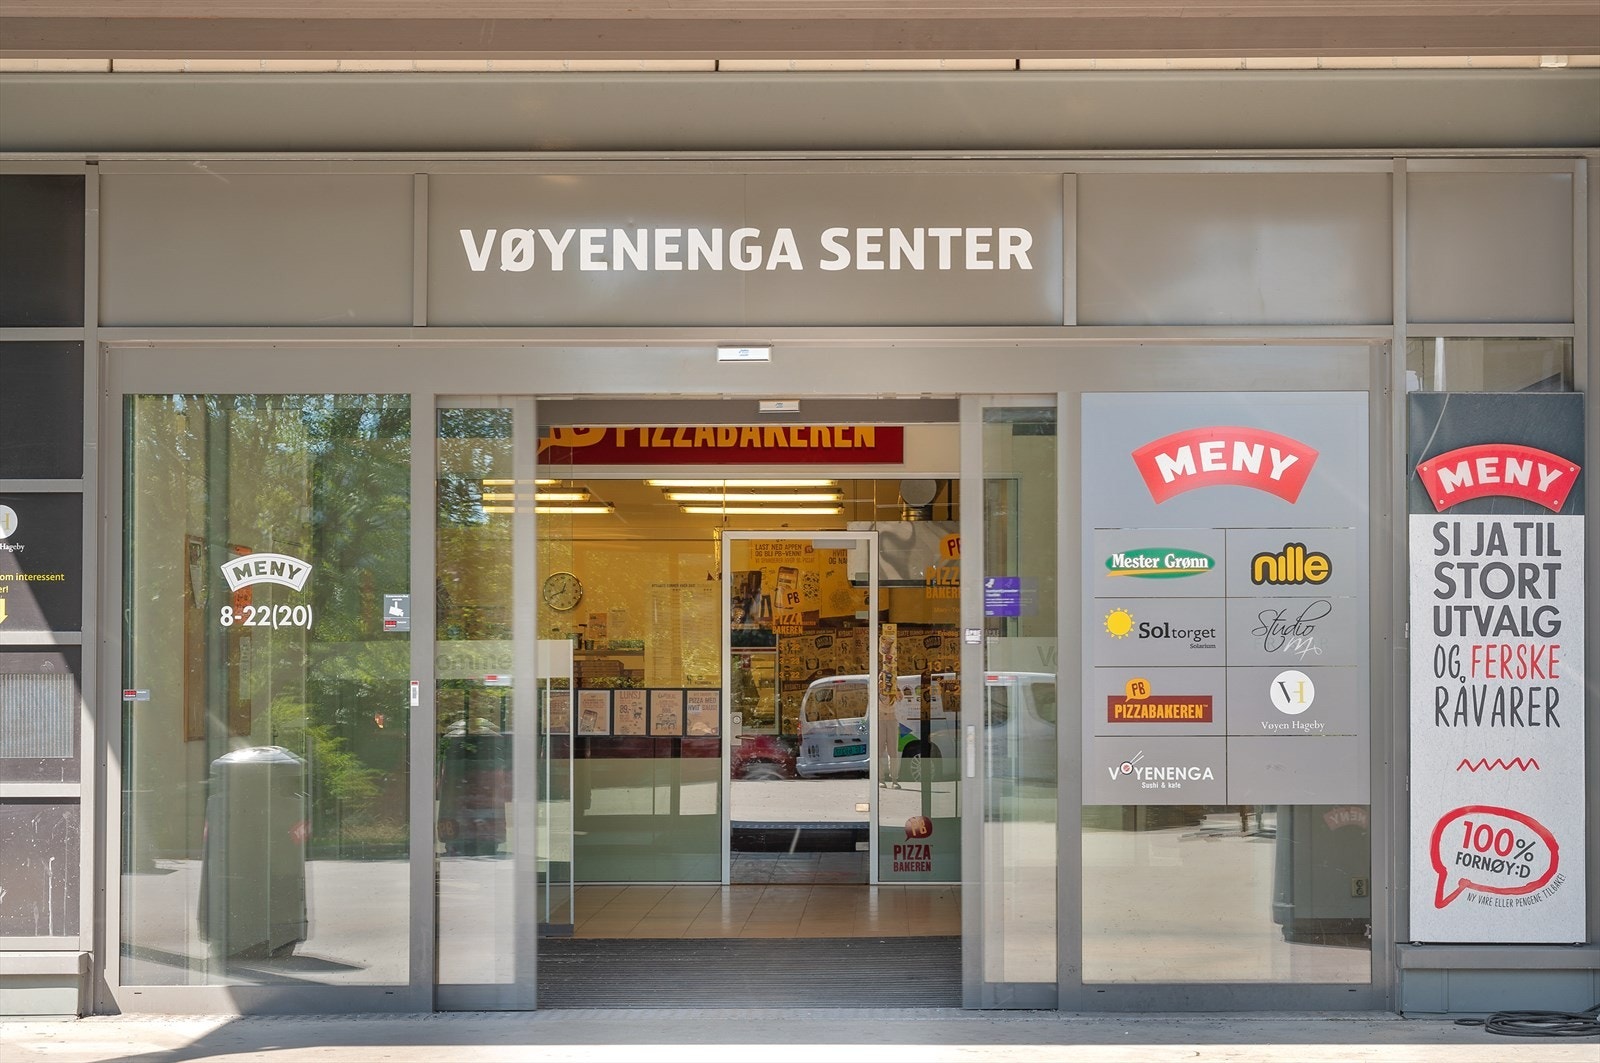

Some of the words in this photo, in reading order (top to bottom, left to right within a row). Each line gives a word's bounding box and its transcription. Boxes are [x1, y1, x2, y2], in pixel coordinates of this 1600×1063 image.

[459, 227, 804, 272] VØYENENGA
[819, 227, 1033, 271] SENTER
[1154, 440, 1299, 484] MENY
[1437, 456, 1563, 494] MENY
[1432, 521, 1461, 557] SI
[1470, 521, 1509, 557] JA
[1513, 521, 1562, 557] TIL
[232, 560, 302, 581] MENY
[1112, 553, 1161, 569] Mester
[1164, 553, 1209, 569] Grønn
[1252, 544, 1331, 584] nille
[15, 572, 65, 581] interessent
[1433, 561, 1562, 599] STORT
[787, 592, 800, 605] PB
[220, 604, 313, 630] 8-22(20)
[772, 612, 803, 626] PIZZA
[772, 626, 803, 634] BAKEREN
[1251, 599, 1332, 652] Studio
[1433, 604, 1562, 638] UTVALG
[1138, 621, 1217, 643] Soltorget
[1433, 643, 1461, 679] OG
[1471, 643, 1561, 680] FERSKE
[620, 691, 641, 699] LUNSJ
[1131, 681, 1146, 697] PB
[1434, 675, 1561, 728] RÅVARER
[1260, 721, 1290, 733] Vøyen
[1292, 720, 1326, 733] Hageby
[1462, 820, 1536, 862] 100%
[893, 862, 932, 872] BAKEREN
[1455, 851, 1532, 879] FORNØY:D
[1467, 892, 1476, 902] NY
[1478, 895, 1493, 906] VARE
[1495, 898, 1514, 908] ELLER
[1516, 894, 1543, 907] PENGENE
[1542, 873, 1567, 899] TILBAKE!
